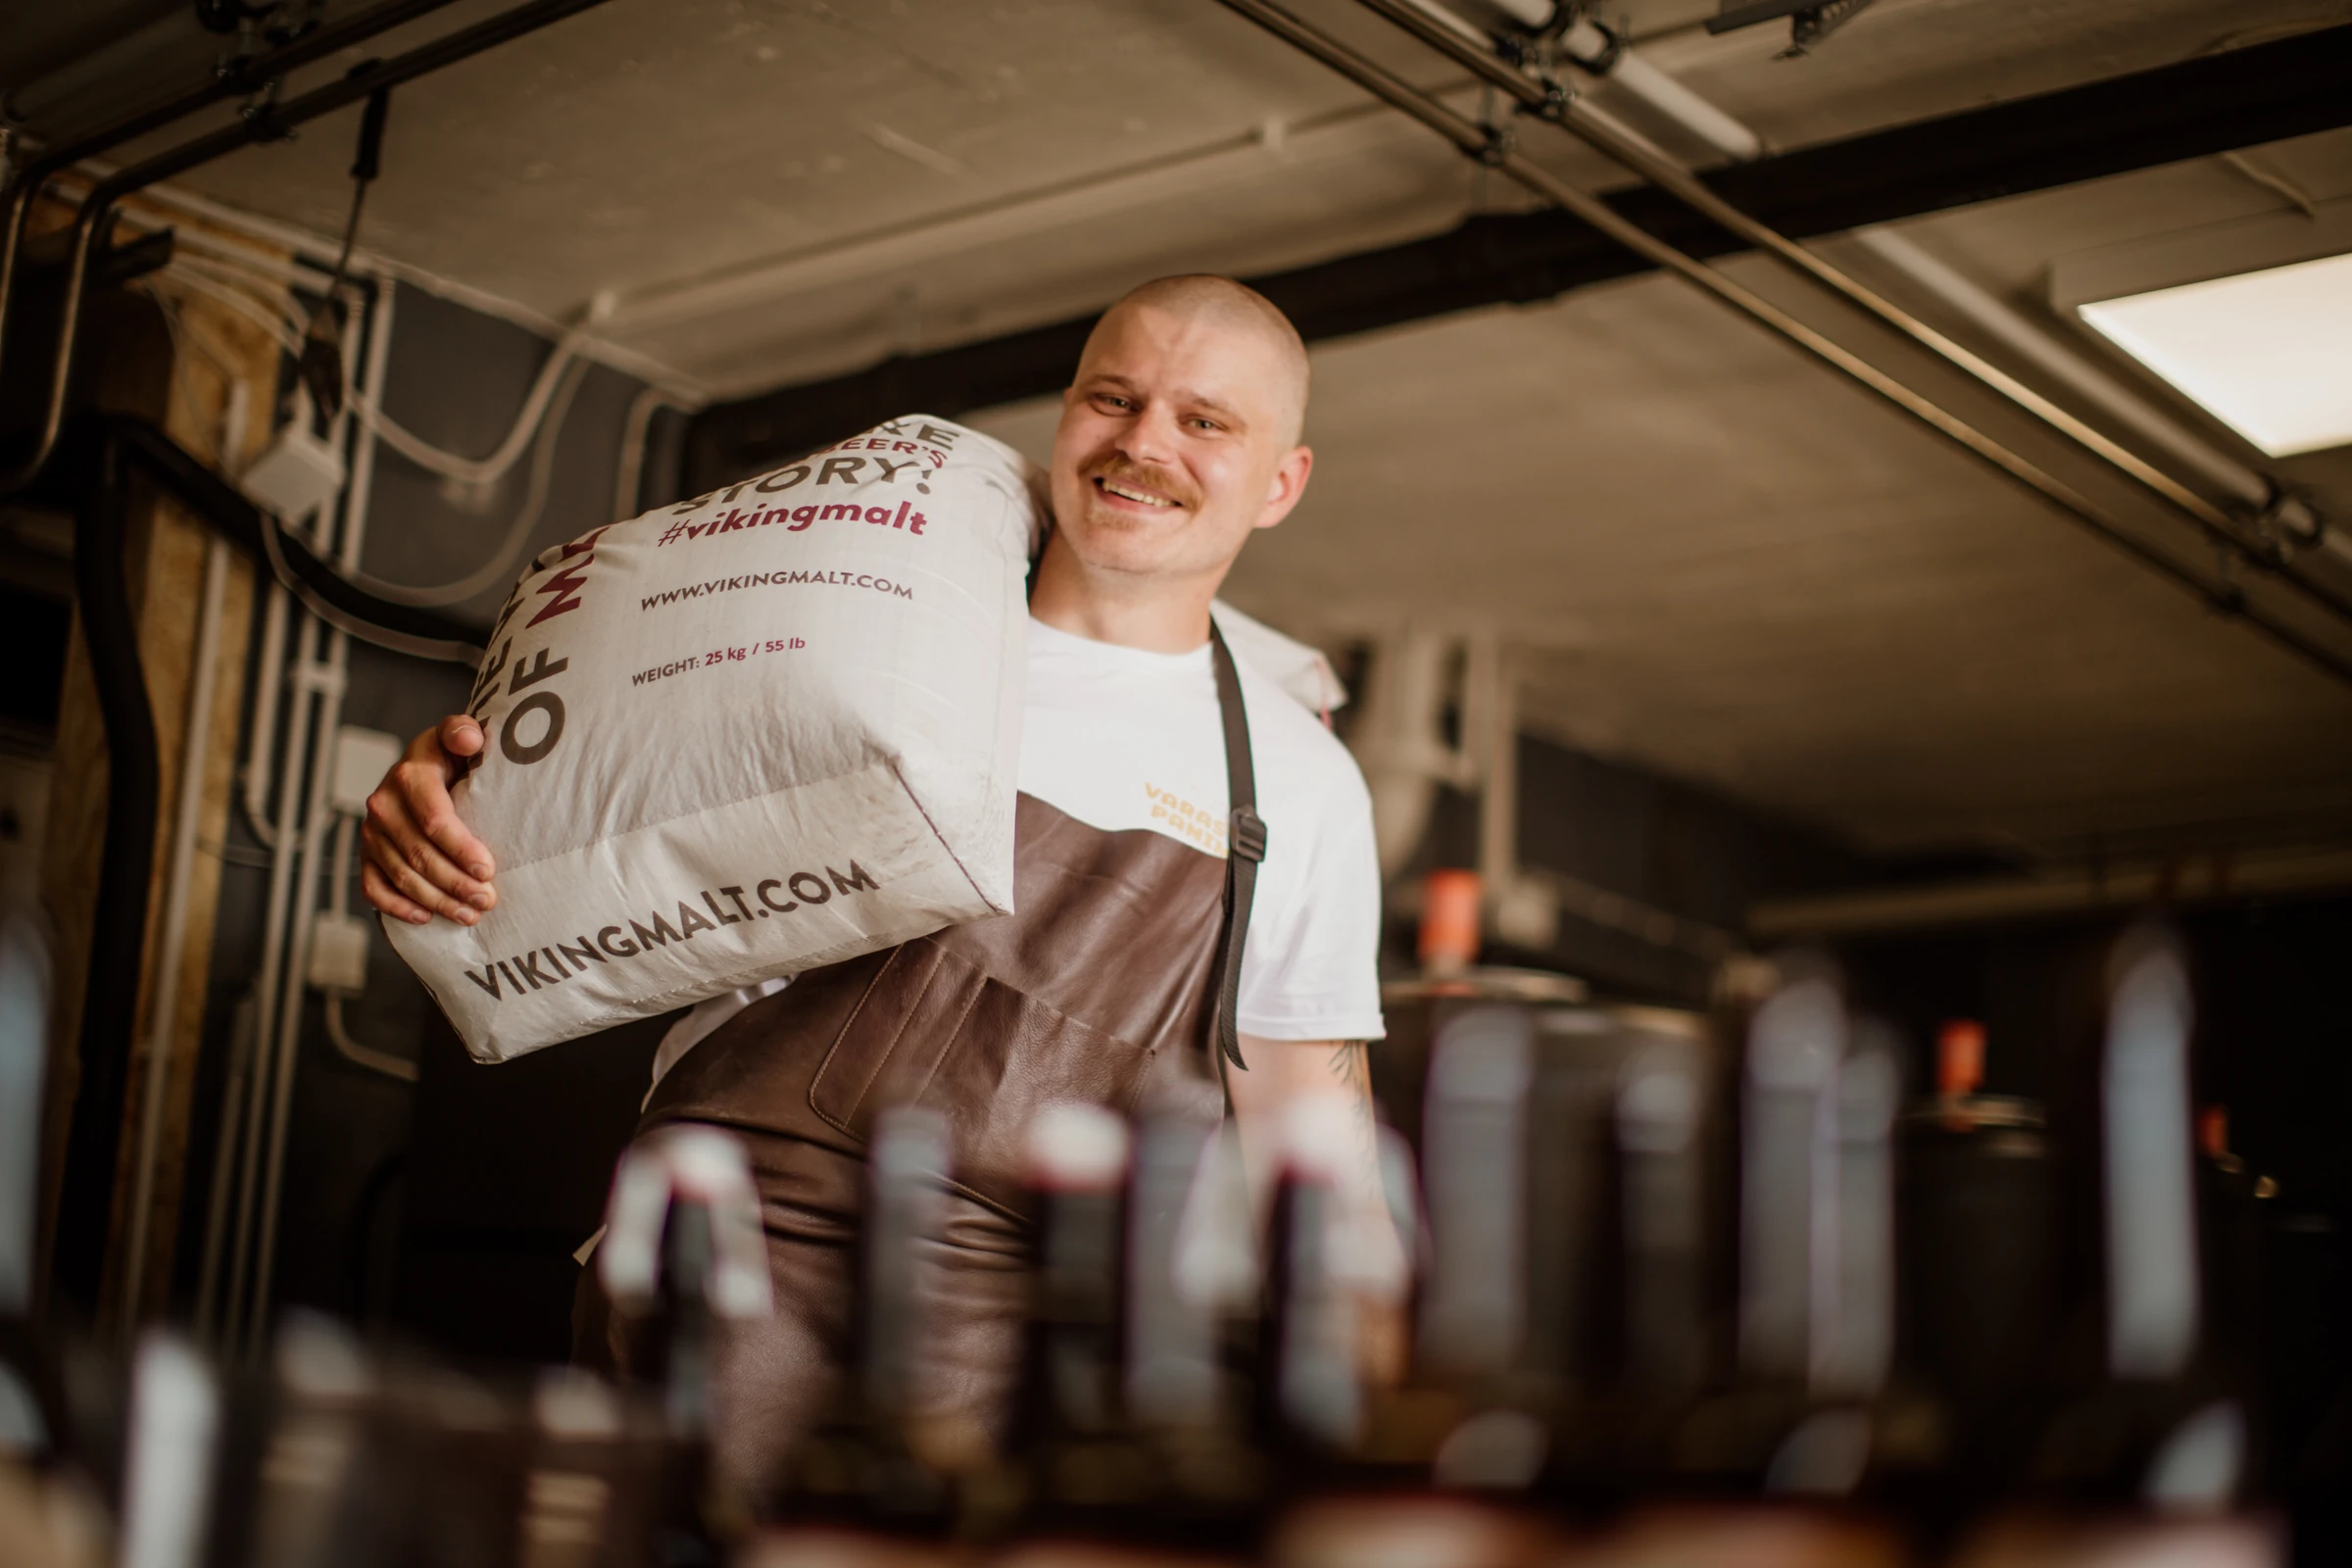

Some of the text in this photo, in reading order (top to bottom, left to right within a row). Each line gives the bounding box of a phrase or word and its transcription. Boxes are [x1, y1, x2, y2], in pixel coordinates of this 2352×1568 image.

[672, 456, 932, 515] STORY!
[658, 501, 927, 548] #vikingmalt
[641, 570, 913, 611] WWW.VIKINGMALT.COM
[632, 637, 806, 687] WEIGHT: 25 kg / 55 lb
[500, 647, 569, 765] OF
[464, 858, 881, 1002] VIKINGMALT.COM
